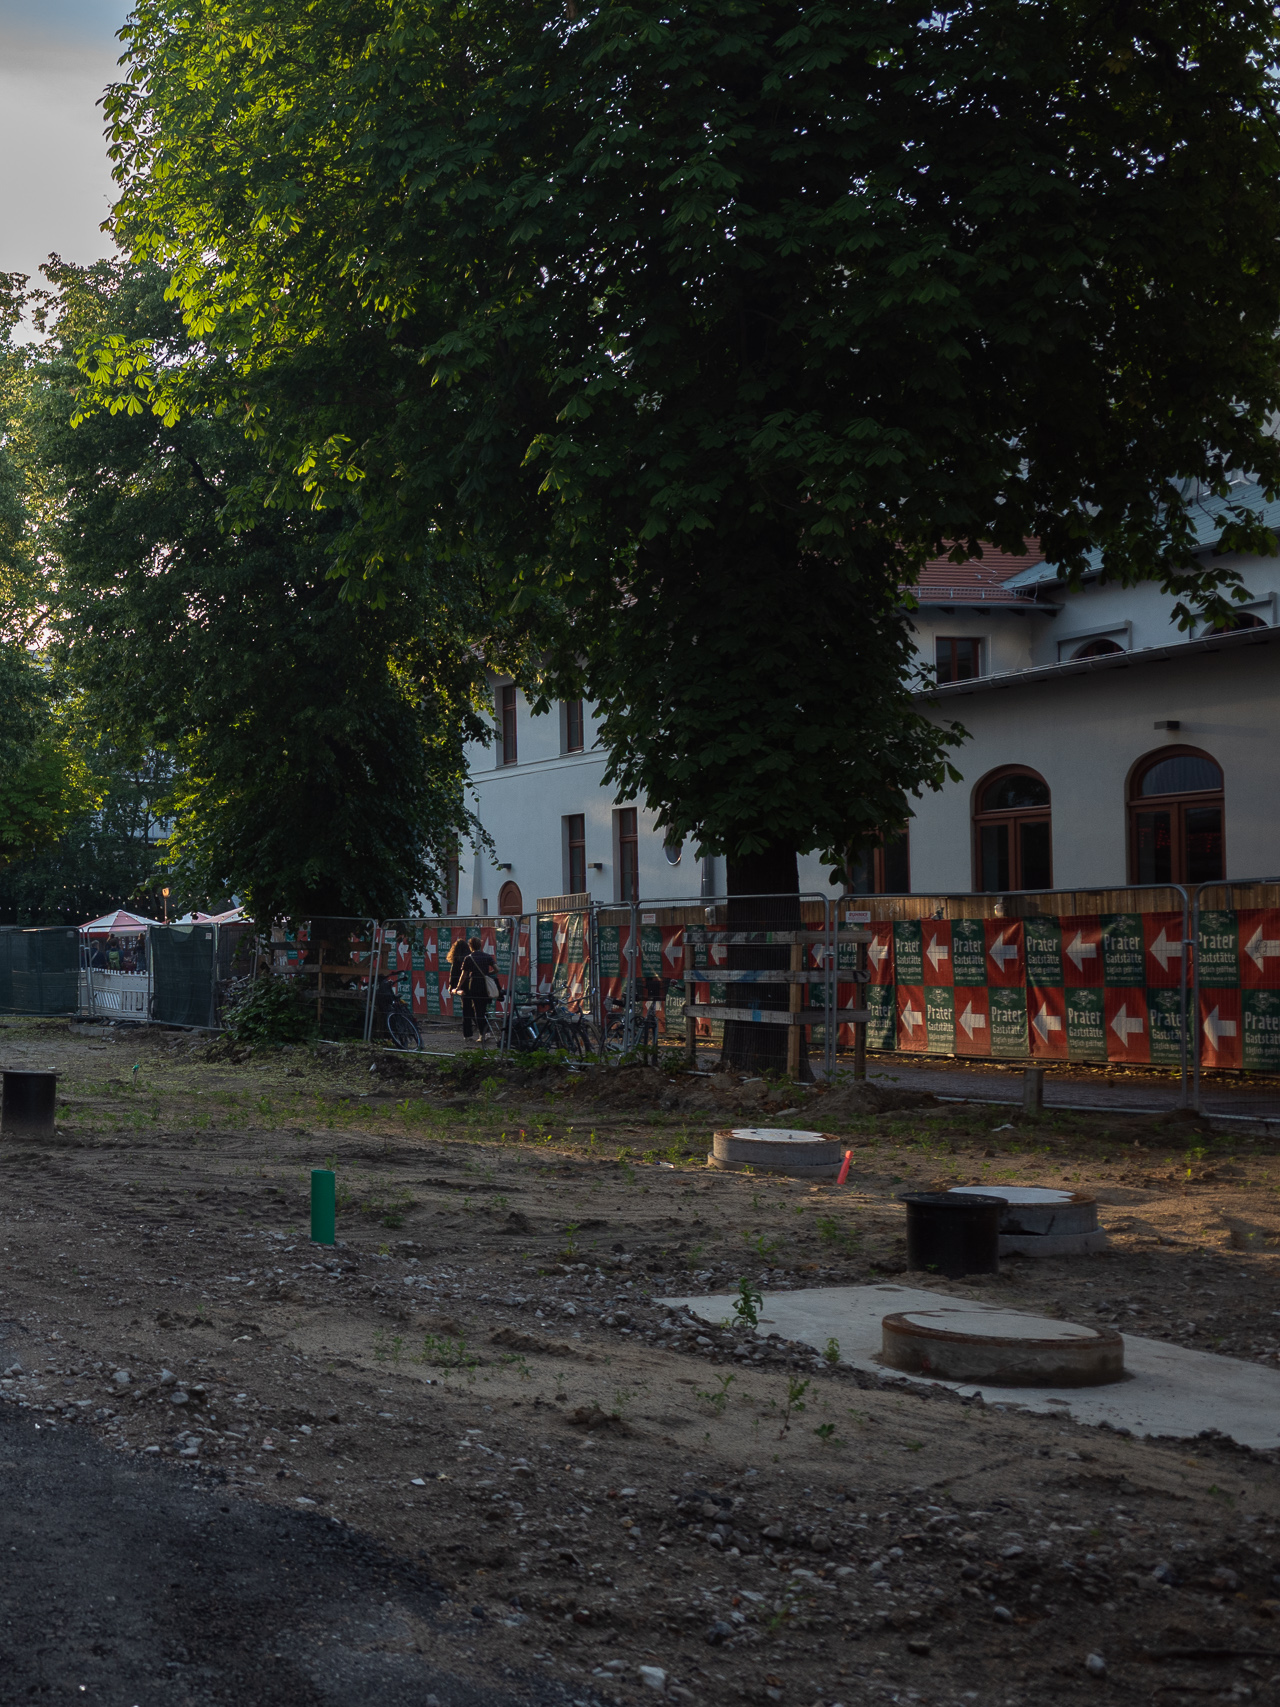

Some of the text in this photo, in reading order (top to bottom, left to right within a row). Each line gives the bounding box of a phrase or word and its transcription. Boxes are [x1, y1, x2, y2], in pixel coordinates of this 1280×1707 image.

[896, 938, 920, 953] Prater
[954, 938, 982, 952] Prater
[1026, 936, 1058, 952] Prater
[1104, 934, 1140, 951] Prater
[954, 955, 984, 964] Gaststätte
[1028, 954, 1060, 964] Gaststätte
[1106, 953, 1142, 964] Gaststätte
[927, 1004, 953, 1020] Prater
[991, 1006, 1021, 1022] Prater
[1068, 1008, 1101, 1026] Prater
[928, 1022, 954, 1032] Gaststätte
[992, 1025, 1024, 1035] Gaststätte
[1069, 1026, 1103, 1038] Gaststätte
